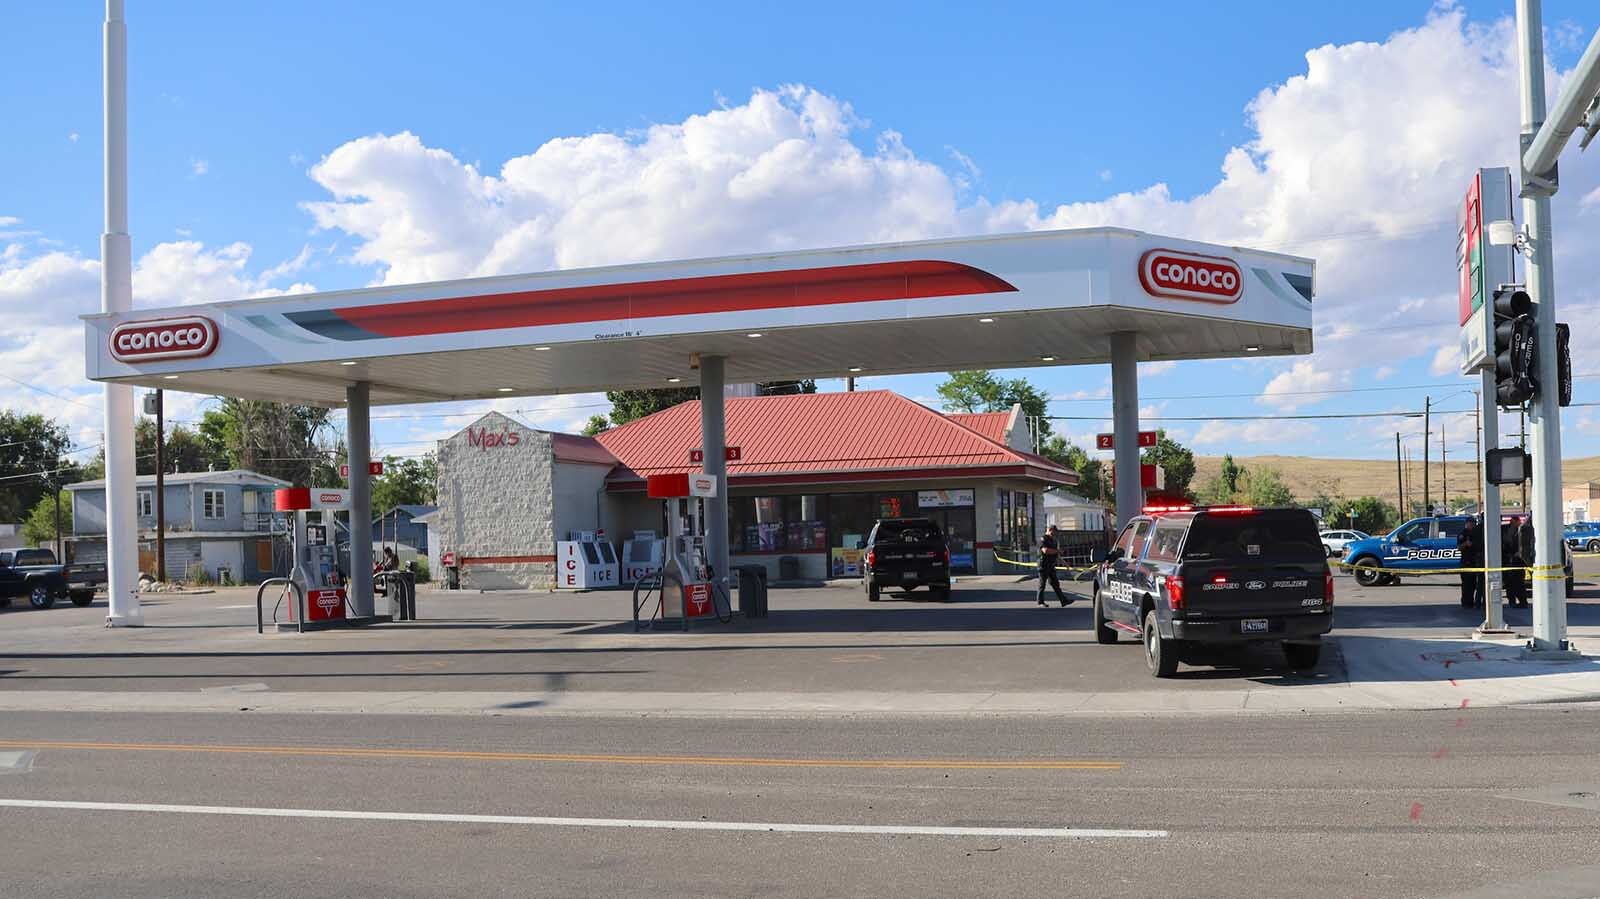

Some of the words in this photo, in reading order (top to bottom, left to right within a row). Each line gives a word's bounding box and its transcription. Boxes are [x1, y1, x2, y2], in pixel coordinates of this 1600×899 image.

[468, 426, 520, 452] Max's
[1102, 437, 1108, 446] 2
[694, 452, 699, 460] 4
[730, 449, 736, 458] 3
[1407, 548, 1462, 560] POLICE
[566, 545, 577, 585] ICE
[593, 570, 612, 582] ICE
[1110, 580, 1133, 603] POLICE
